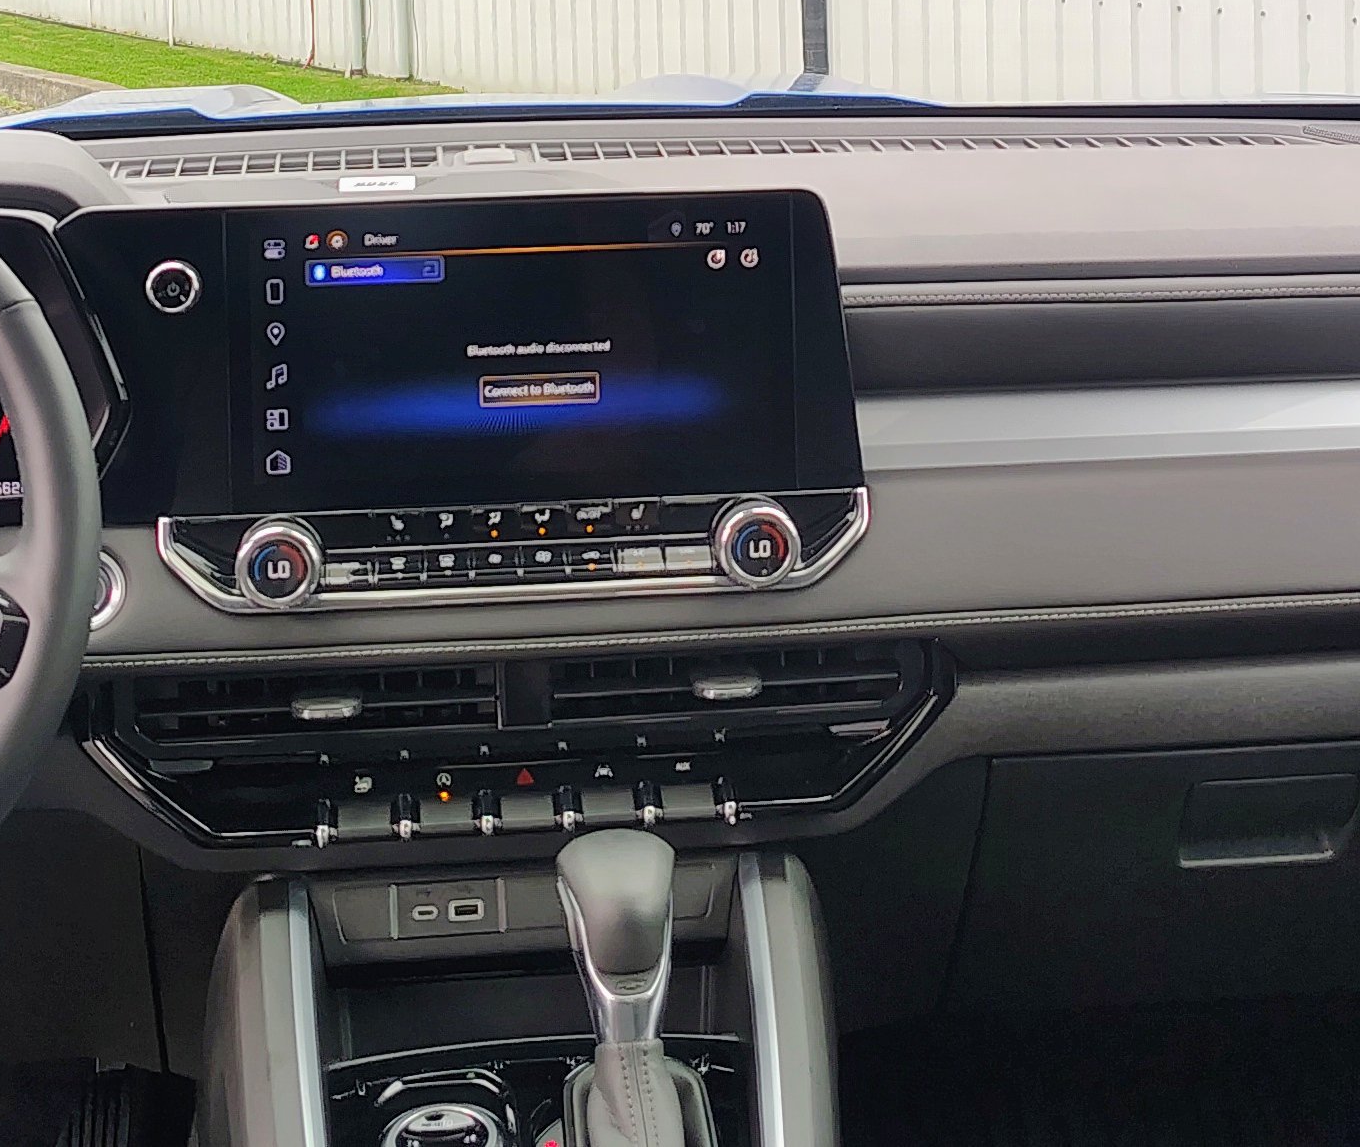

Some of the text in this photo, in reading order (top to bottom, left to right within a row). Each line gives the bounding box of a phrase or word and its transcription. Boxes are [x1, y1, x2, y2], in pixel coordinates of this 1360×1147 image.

[726, 221, 746, 234] 1:17
[363, 233, 399, 246] Driver
[330, 264, 384, 278] Bluetooth
[466, 339, 611, 357] Bluetooth audio disconnected
[484, 381, 595, 398] Connect to Bluetooth
[749, 539, 771, 559] LO
[267, 560, 290, 580] LO
